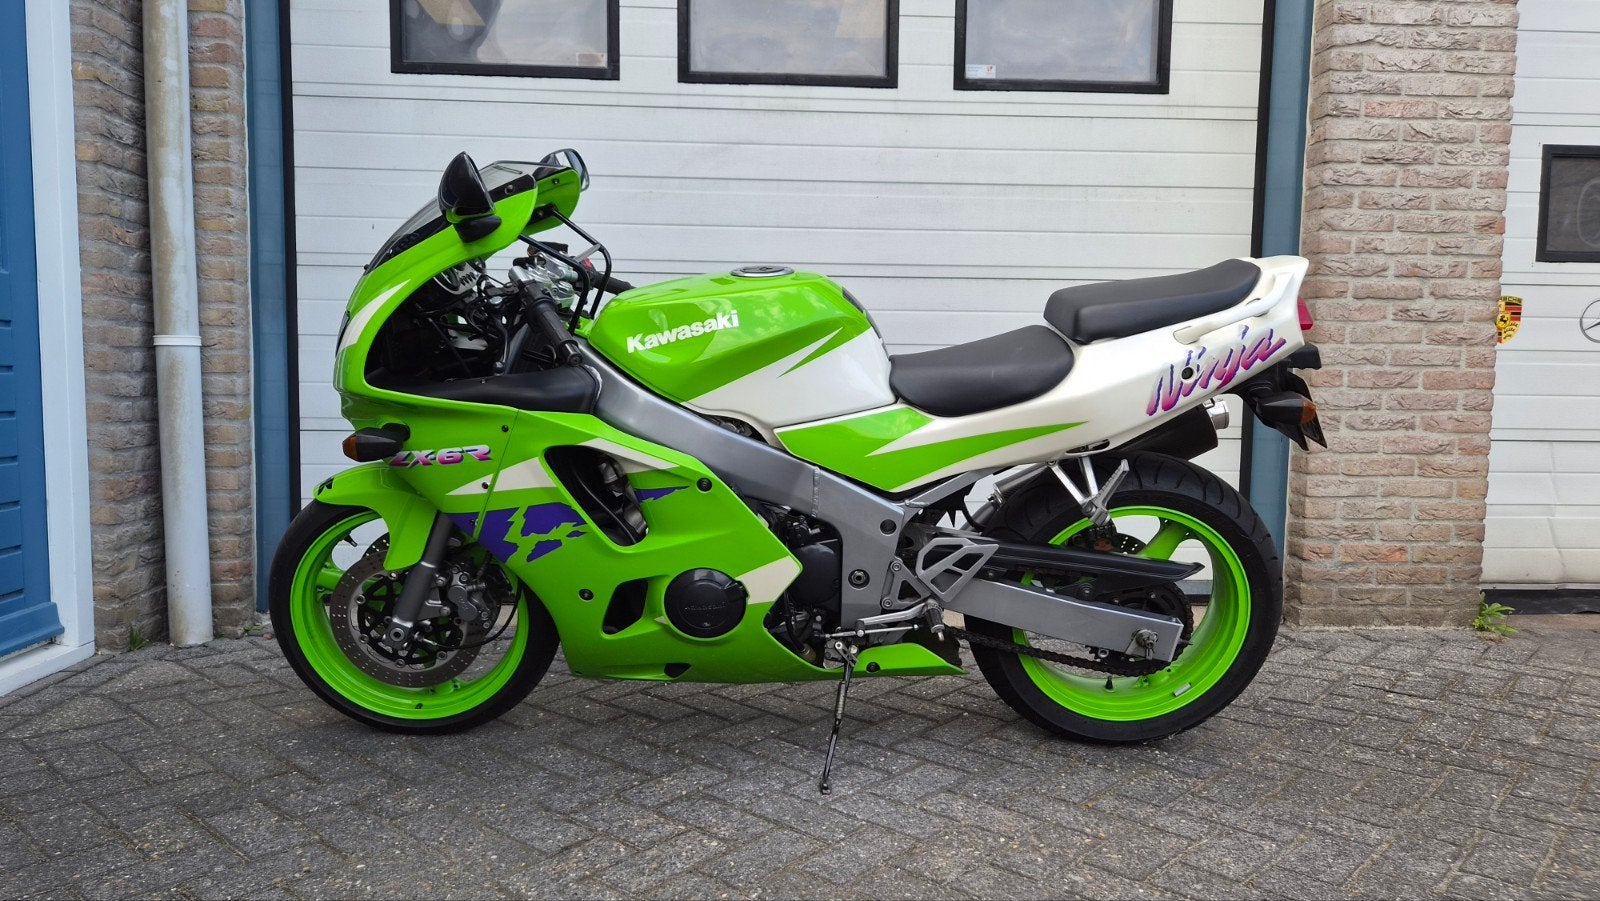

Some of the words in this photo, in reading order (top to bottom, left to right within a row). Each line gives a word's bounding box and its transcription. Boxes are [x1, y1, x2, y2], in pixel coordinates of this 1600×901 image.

[627, 310, 739, 353] Kawasaki
[1146, 325, 1286, 416] Ninja
[389, 445, 492, 468] ZX-6R
